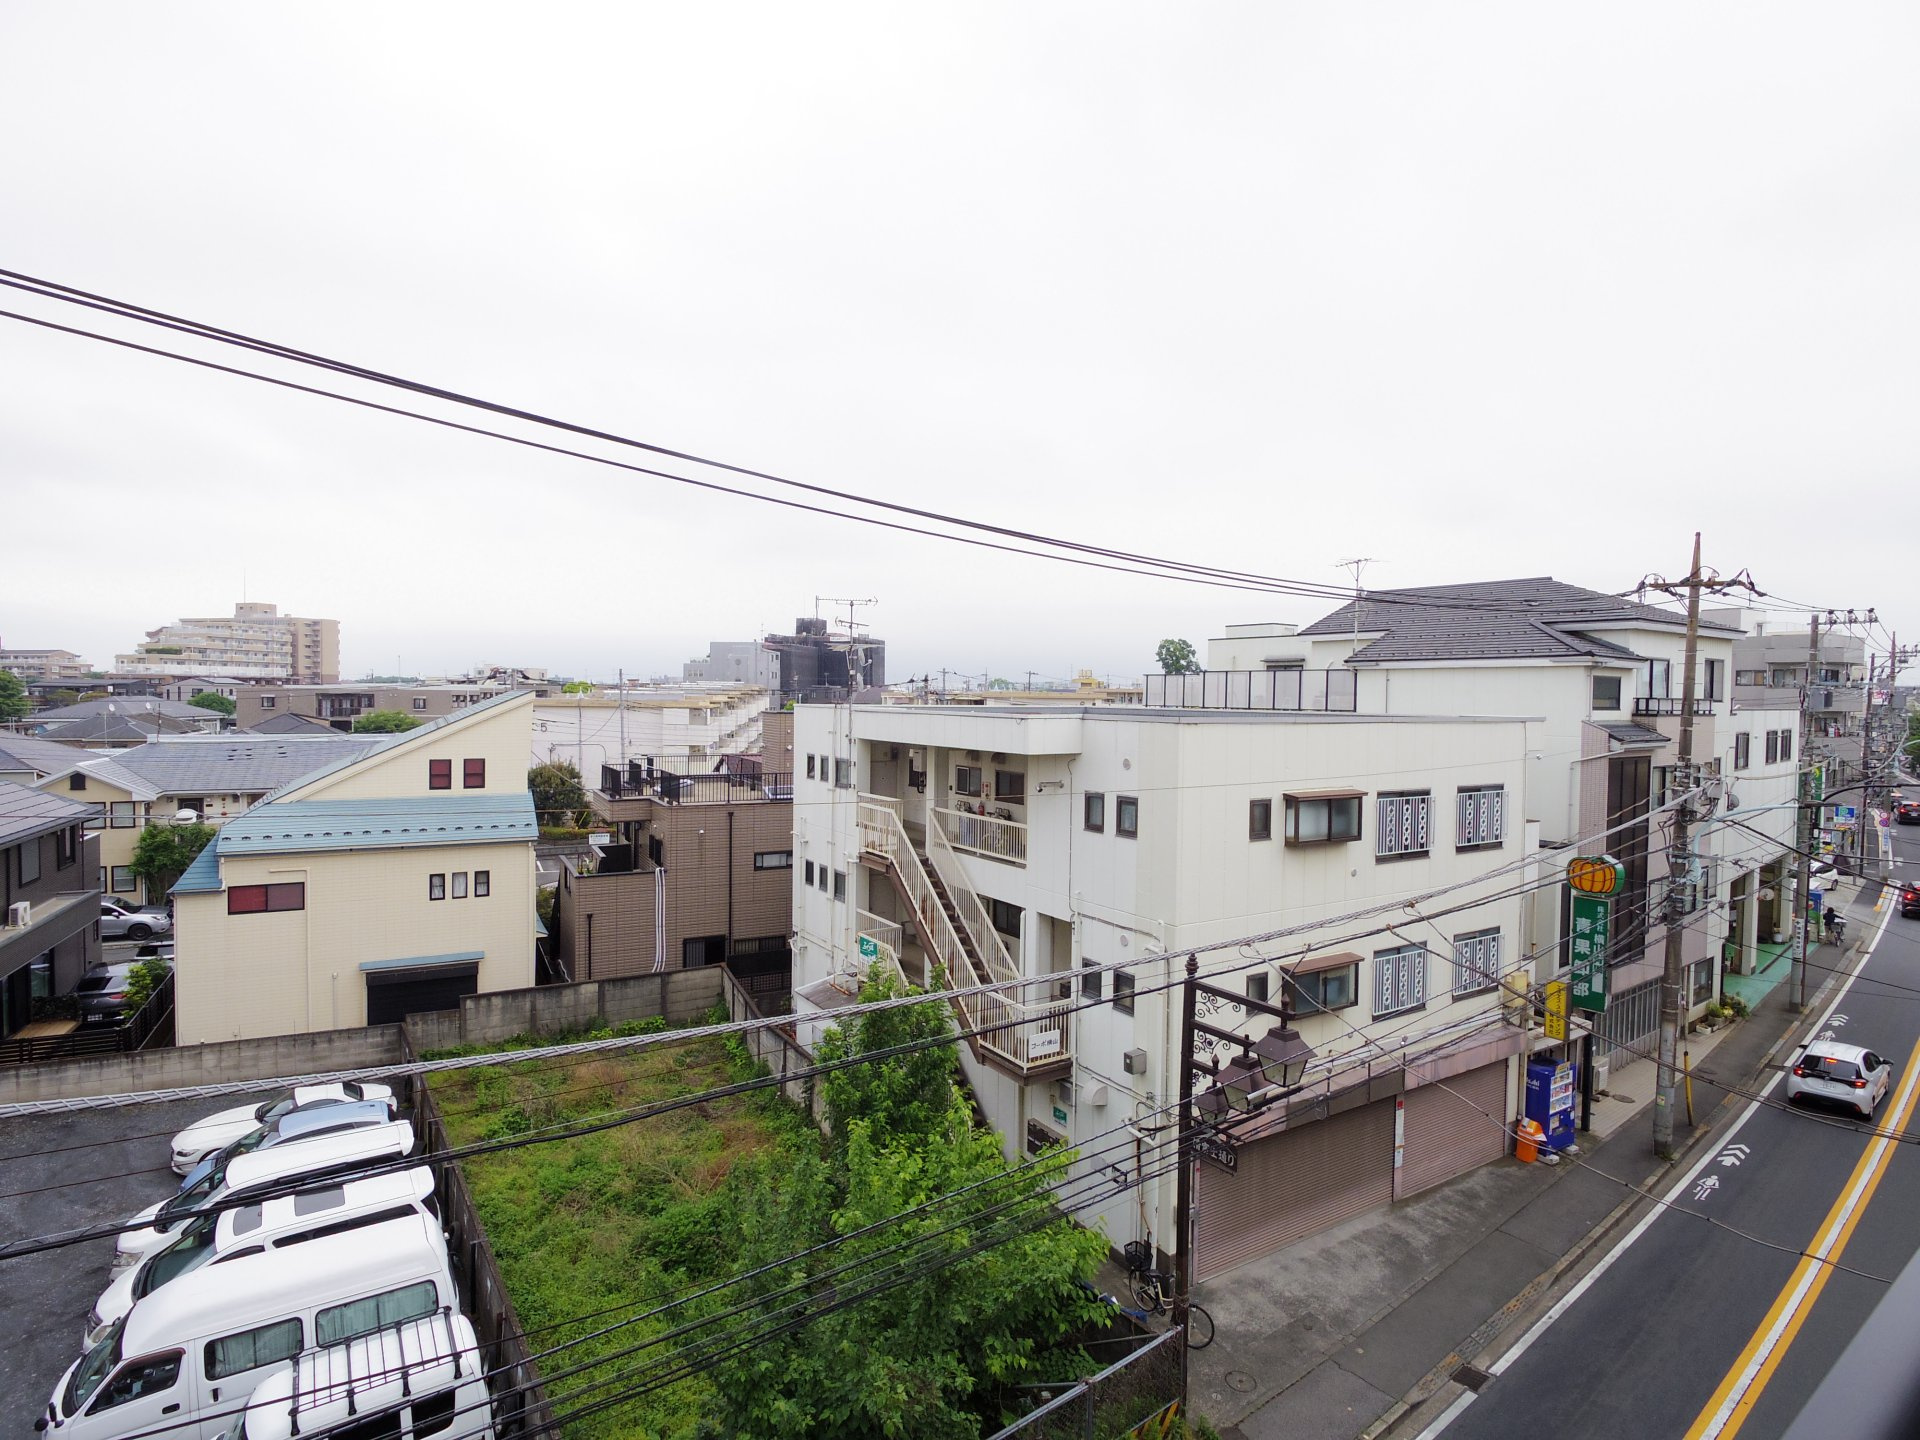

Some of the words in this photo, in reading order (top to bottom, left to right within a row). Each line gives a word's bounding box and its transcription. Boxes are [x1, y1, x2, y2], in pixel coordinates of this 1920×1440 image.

[1031, 1038, 1059, 1050] コーポ横山
